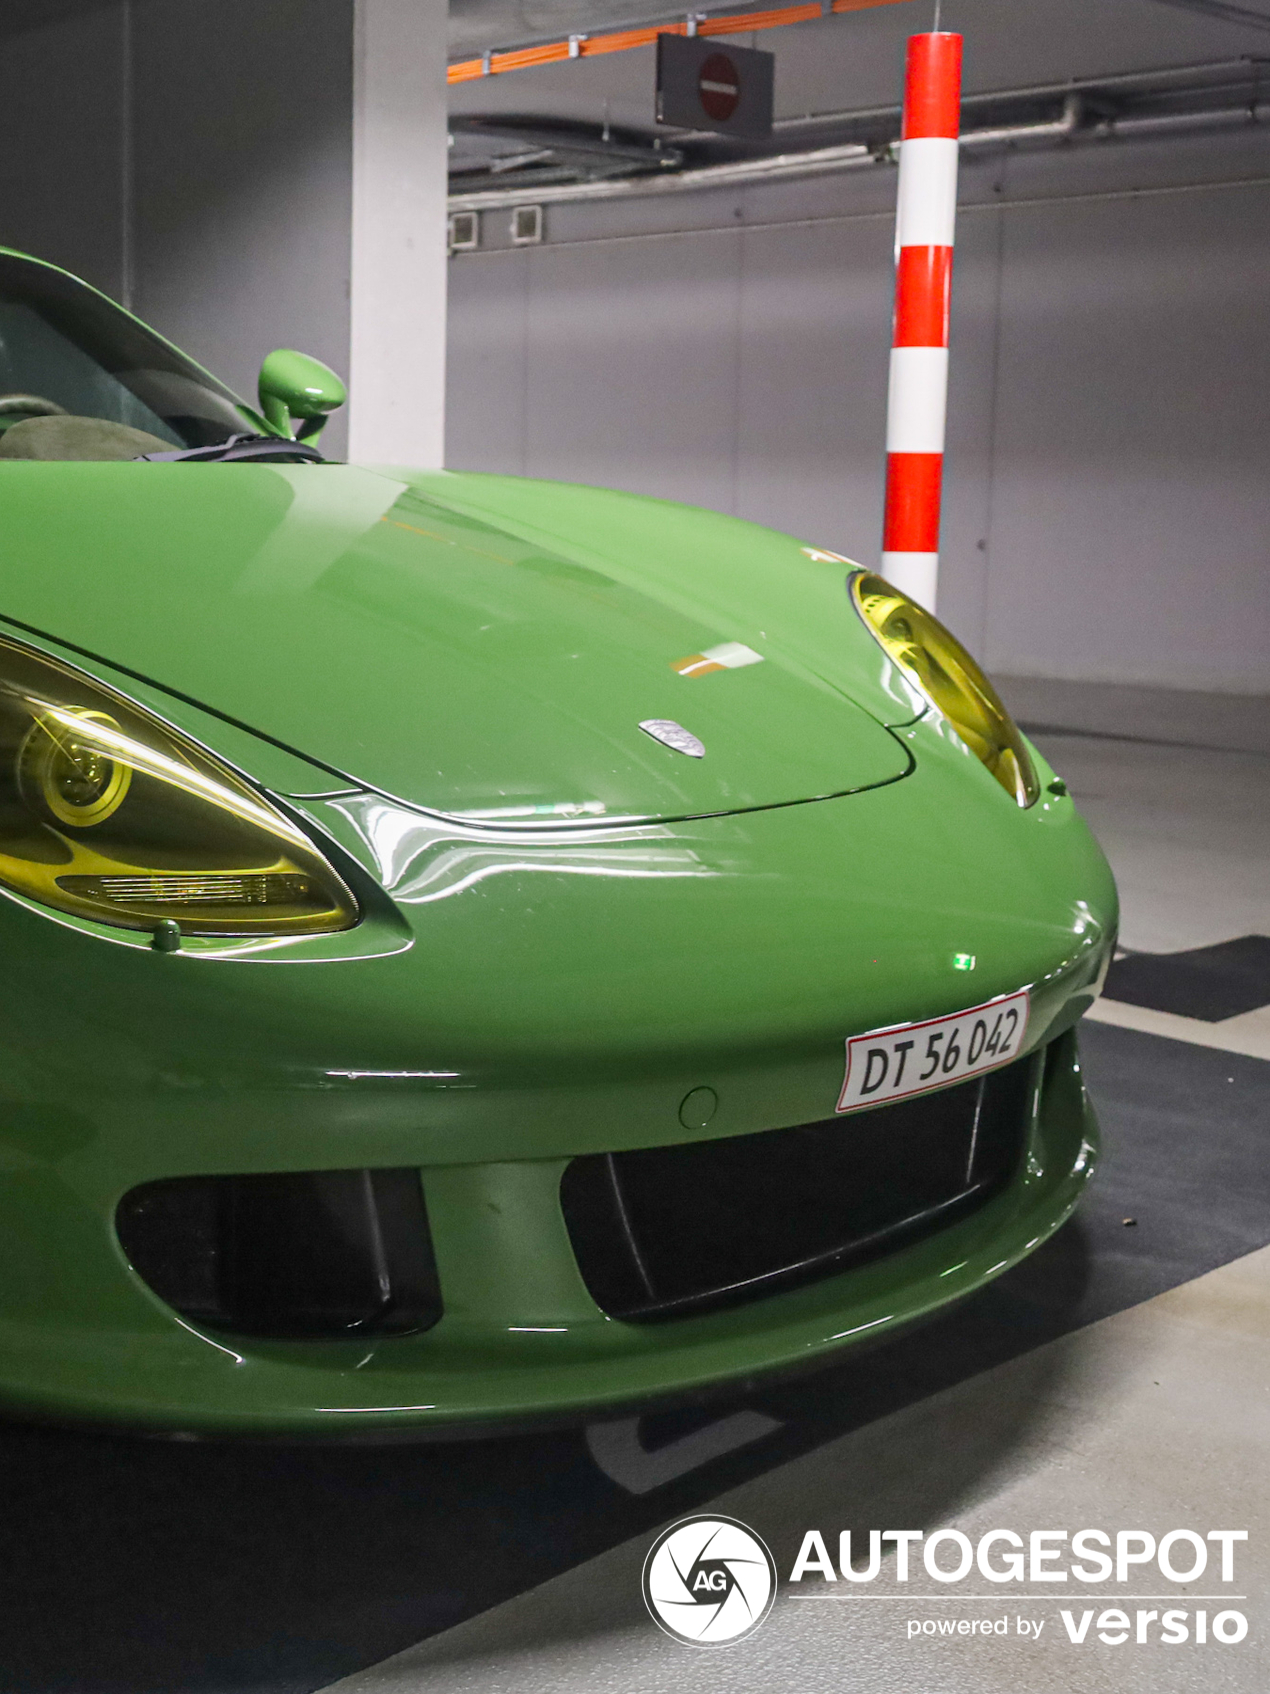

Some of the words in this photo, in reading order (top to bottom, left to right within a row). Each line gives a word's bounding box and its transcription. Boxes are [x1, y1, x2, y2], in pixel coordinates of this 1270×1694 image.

[859, 1040, 915, 1096] DT
[919, 1028, 961, 1081] 56
[966, 1008, 1019, 1066] 042
